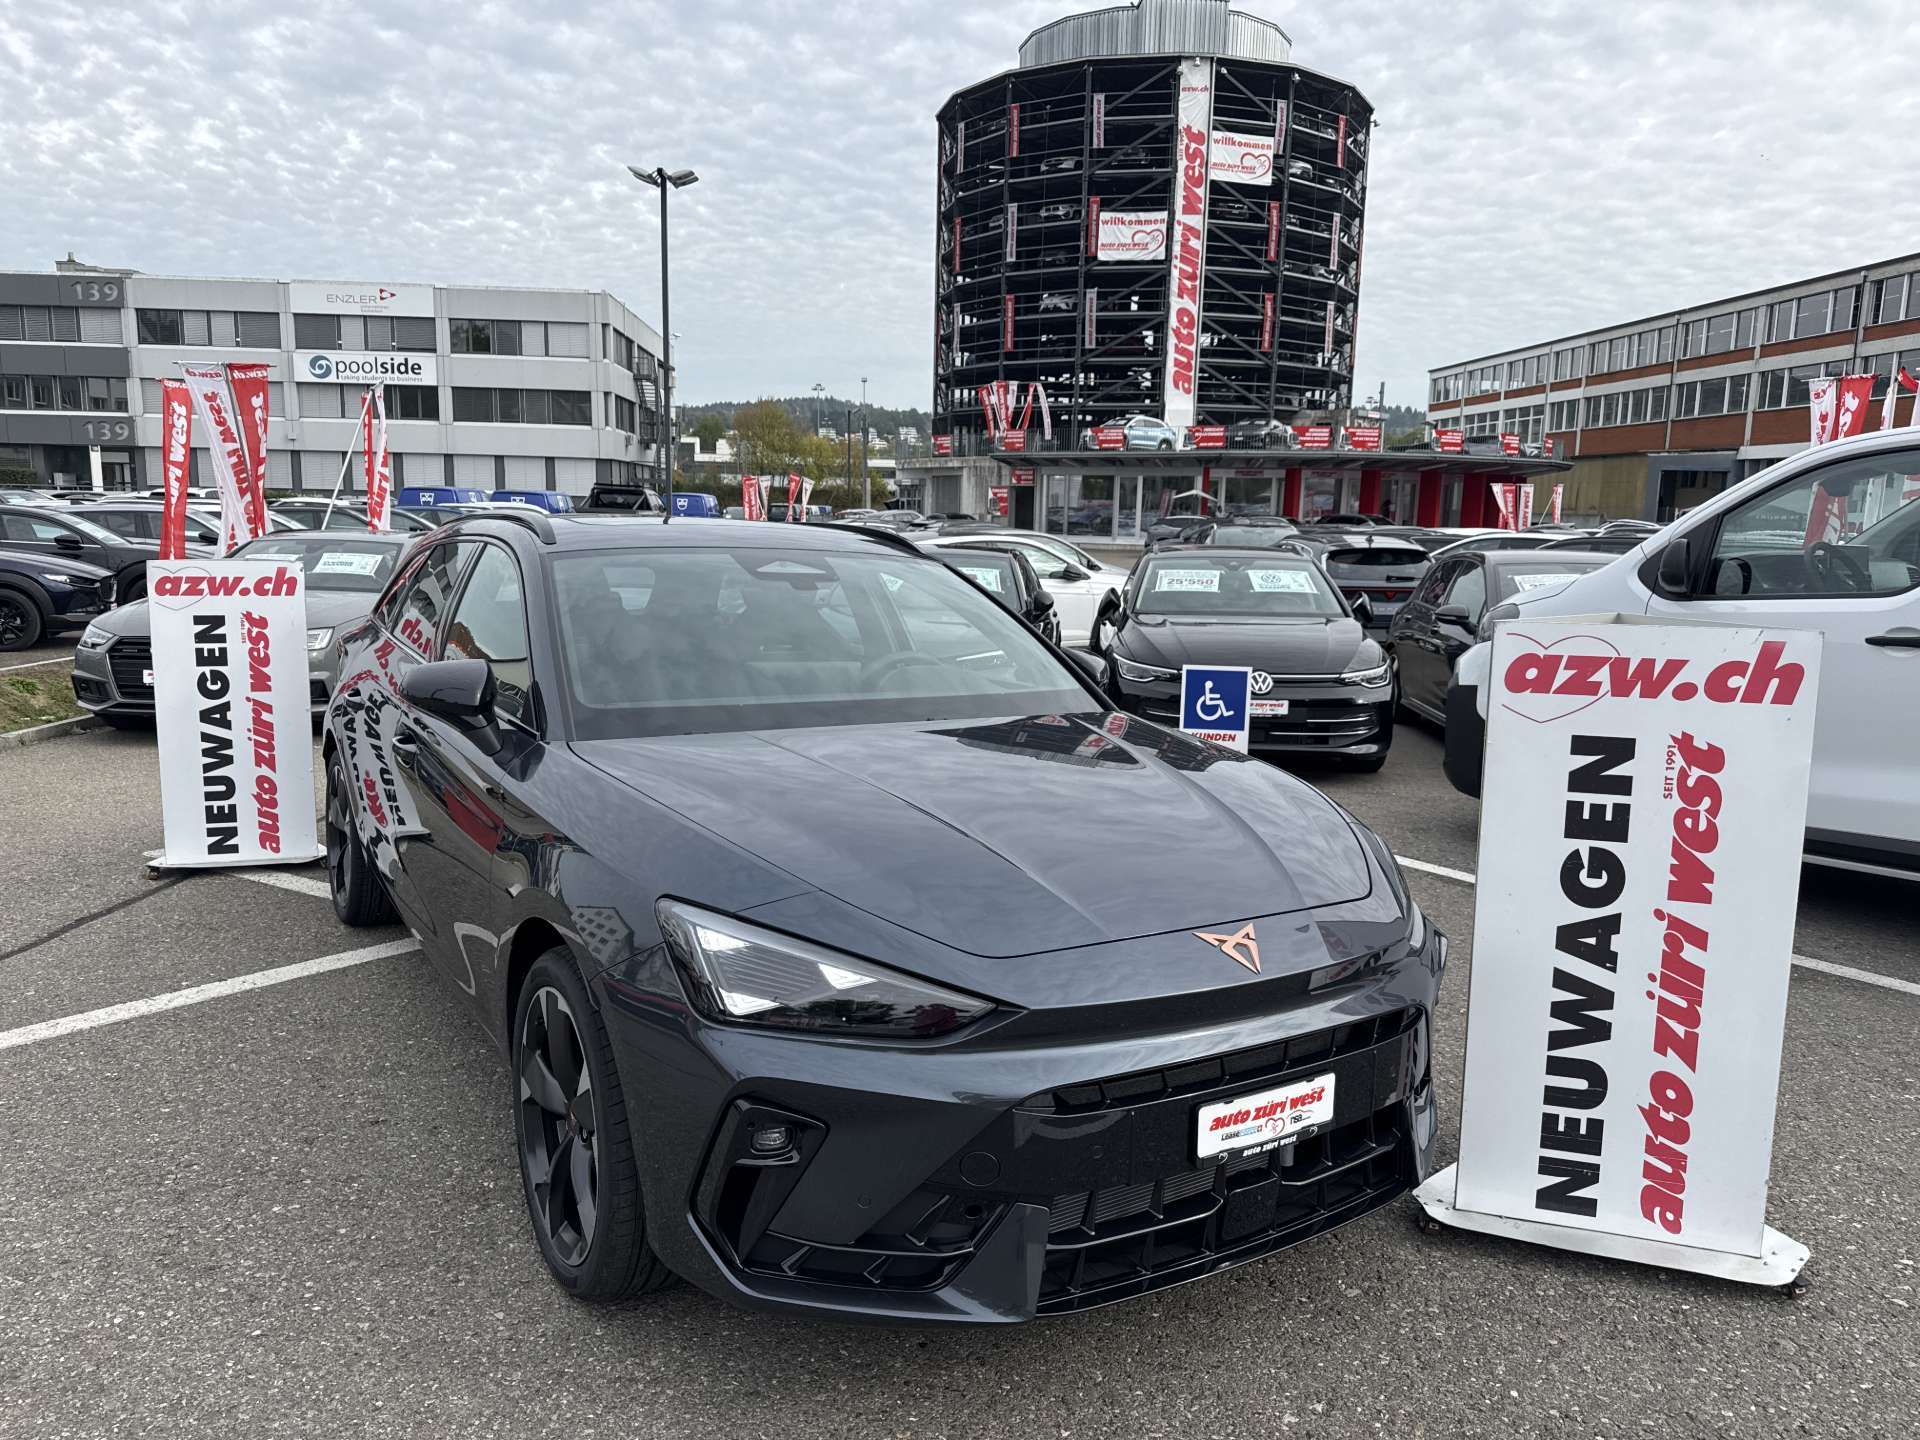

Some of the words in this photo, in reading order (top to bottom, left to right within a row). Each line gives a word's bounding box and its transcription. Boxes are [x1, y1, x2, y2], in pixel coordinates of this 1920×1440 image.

[1181, 83, 1209, 93] azw.ch
[1182, 124, 1206, 215] west
[1213, 136, 1272, 150] willkommen
[1101, 216, 1165, 226] willkommen
[71, 281, 119, 301] 139
[1172, 219, 1201, 305] züri
[326, 294, 377, 304] ENZLER
[335, 357, 422, 379] poolside
[1171, 307, 1197, 395] auto
[83, 421, 129, 440] 139
[170, 401, 187, 462] west
[155, 567, 298, 597] azw.ch
[243, 610, 272, 693] west
[1504, 641, 1805, 705] azw.ch
[193, 615, 240, 855] NEUWAGEN
[245, 697, 277, 773] züri
[1665, 744, 1677, 772] 1991
[250, 774, 281, 853] auto
[1663, 776, 1674, 799] SEIT
[1667, 731, 1725, 905] west
[1536, 735, 1636, 1217] NEUWAGEN
[1647, 909, 1709, 1073] züri
[1209, 1108, 1251, 1132] auto
[1251, 1096, 1288, 1121] züri
[1289, 1086, 1326, 1110] west
[1242, 1145, 1261, 1158] auto
[1262, 1139, 1279, 1151] züri
[1279, 1133, 1298, 1147] west
[1636, 1072, 1694, 1234] auto
